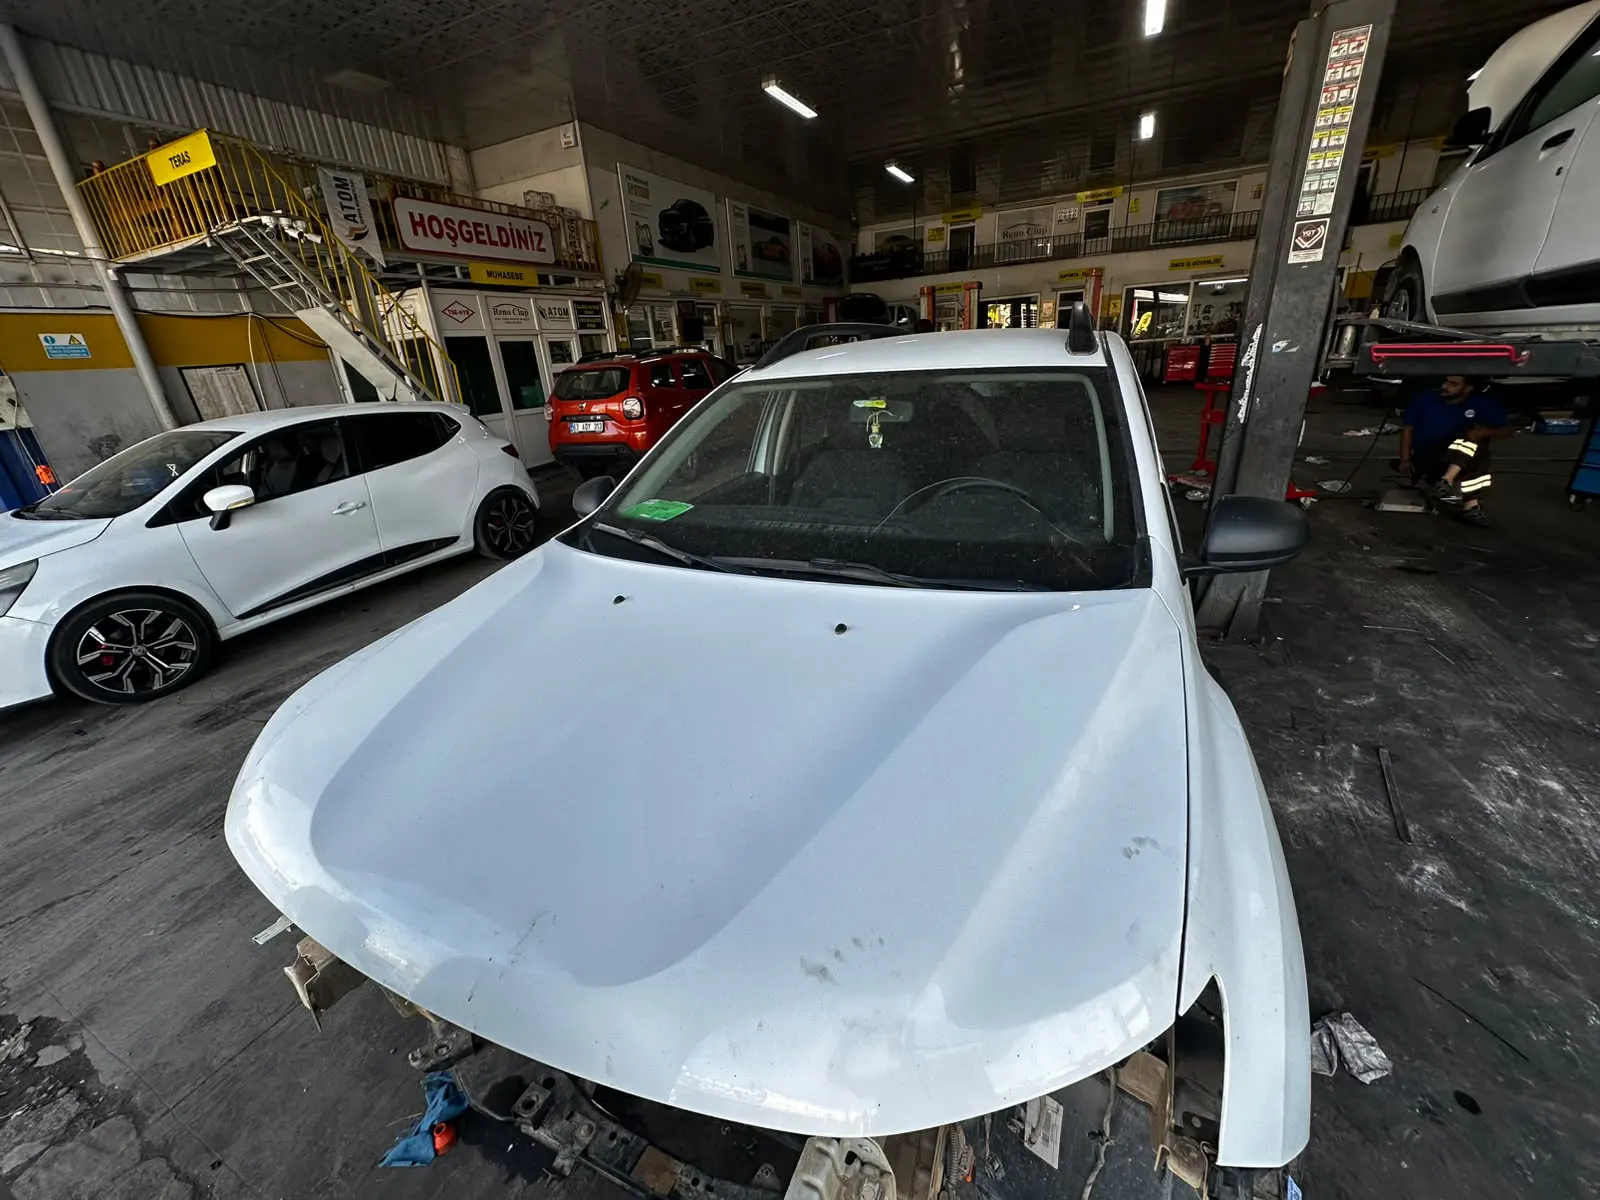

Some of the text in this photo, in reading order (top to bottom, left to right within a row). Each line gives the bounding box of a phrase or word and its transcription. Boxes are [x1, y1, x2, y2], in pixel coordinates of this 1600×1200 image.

[168, 151, 191, 170] TERAS
[333, 176, 358, 224] ATOM
[408, 211, 546, 252] HOŞGELDİNİZ
[486, 269, 524, 281] MUHASEBE
[548, 306, 569, 317] ATOM
